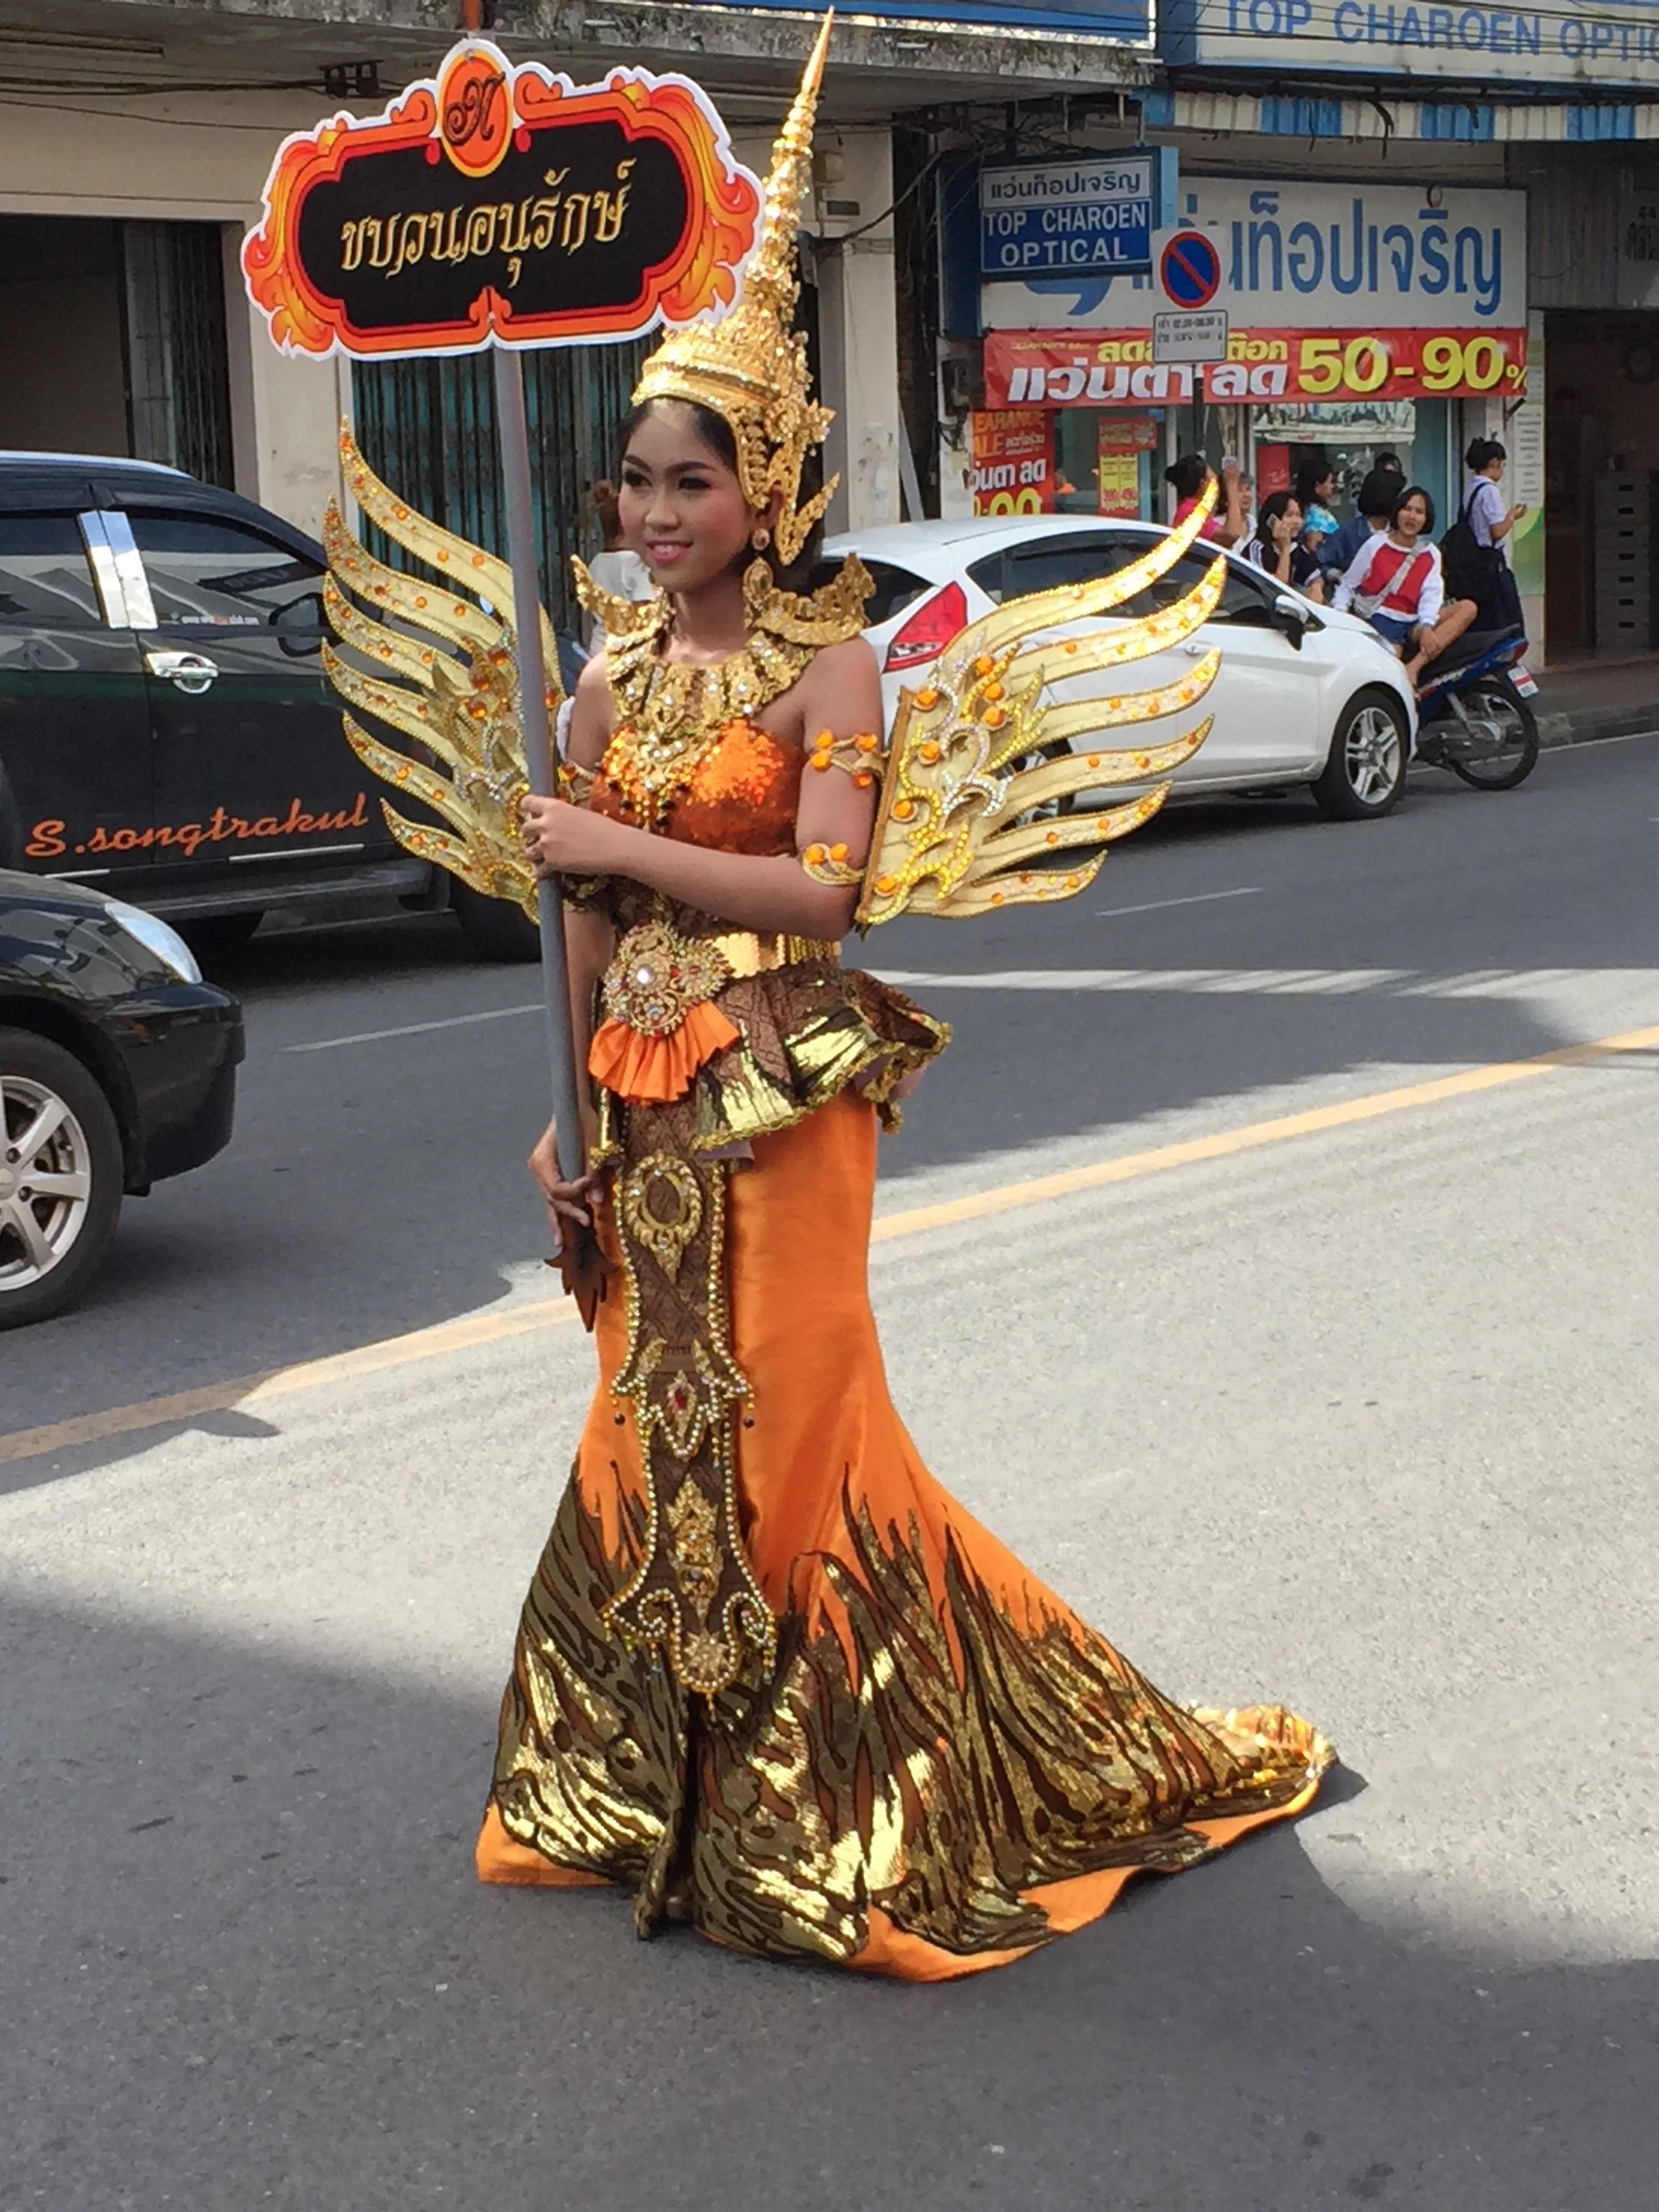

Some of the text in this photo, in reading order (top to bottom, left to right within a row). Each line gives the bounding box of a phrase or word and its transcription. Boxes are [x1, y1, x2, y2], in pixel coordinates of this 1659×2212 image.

[1223, 0, 1312, 34] TOP
[1334, 1, 1542, 56] CHAROEN
[991, 170, 1141, 199] แว่นท็อปเจริญ
[340, 157, 638, 289] ขบวนอนุรักษ์
[985, 204, 1146, 237] TOP CHAROEN
[1000, 237, 1128, 267] OPTICAL
[1007, 357, 1193, 401] แว่นตา
[1211, 363, 1288, 397] ลด
